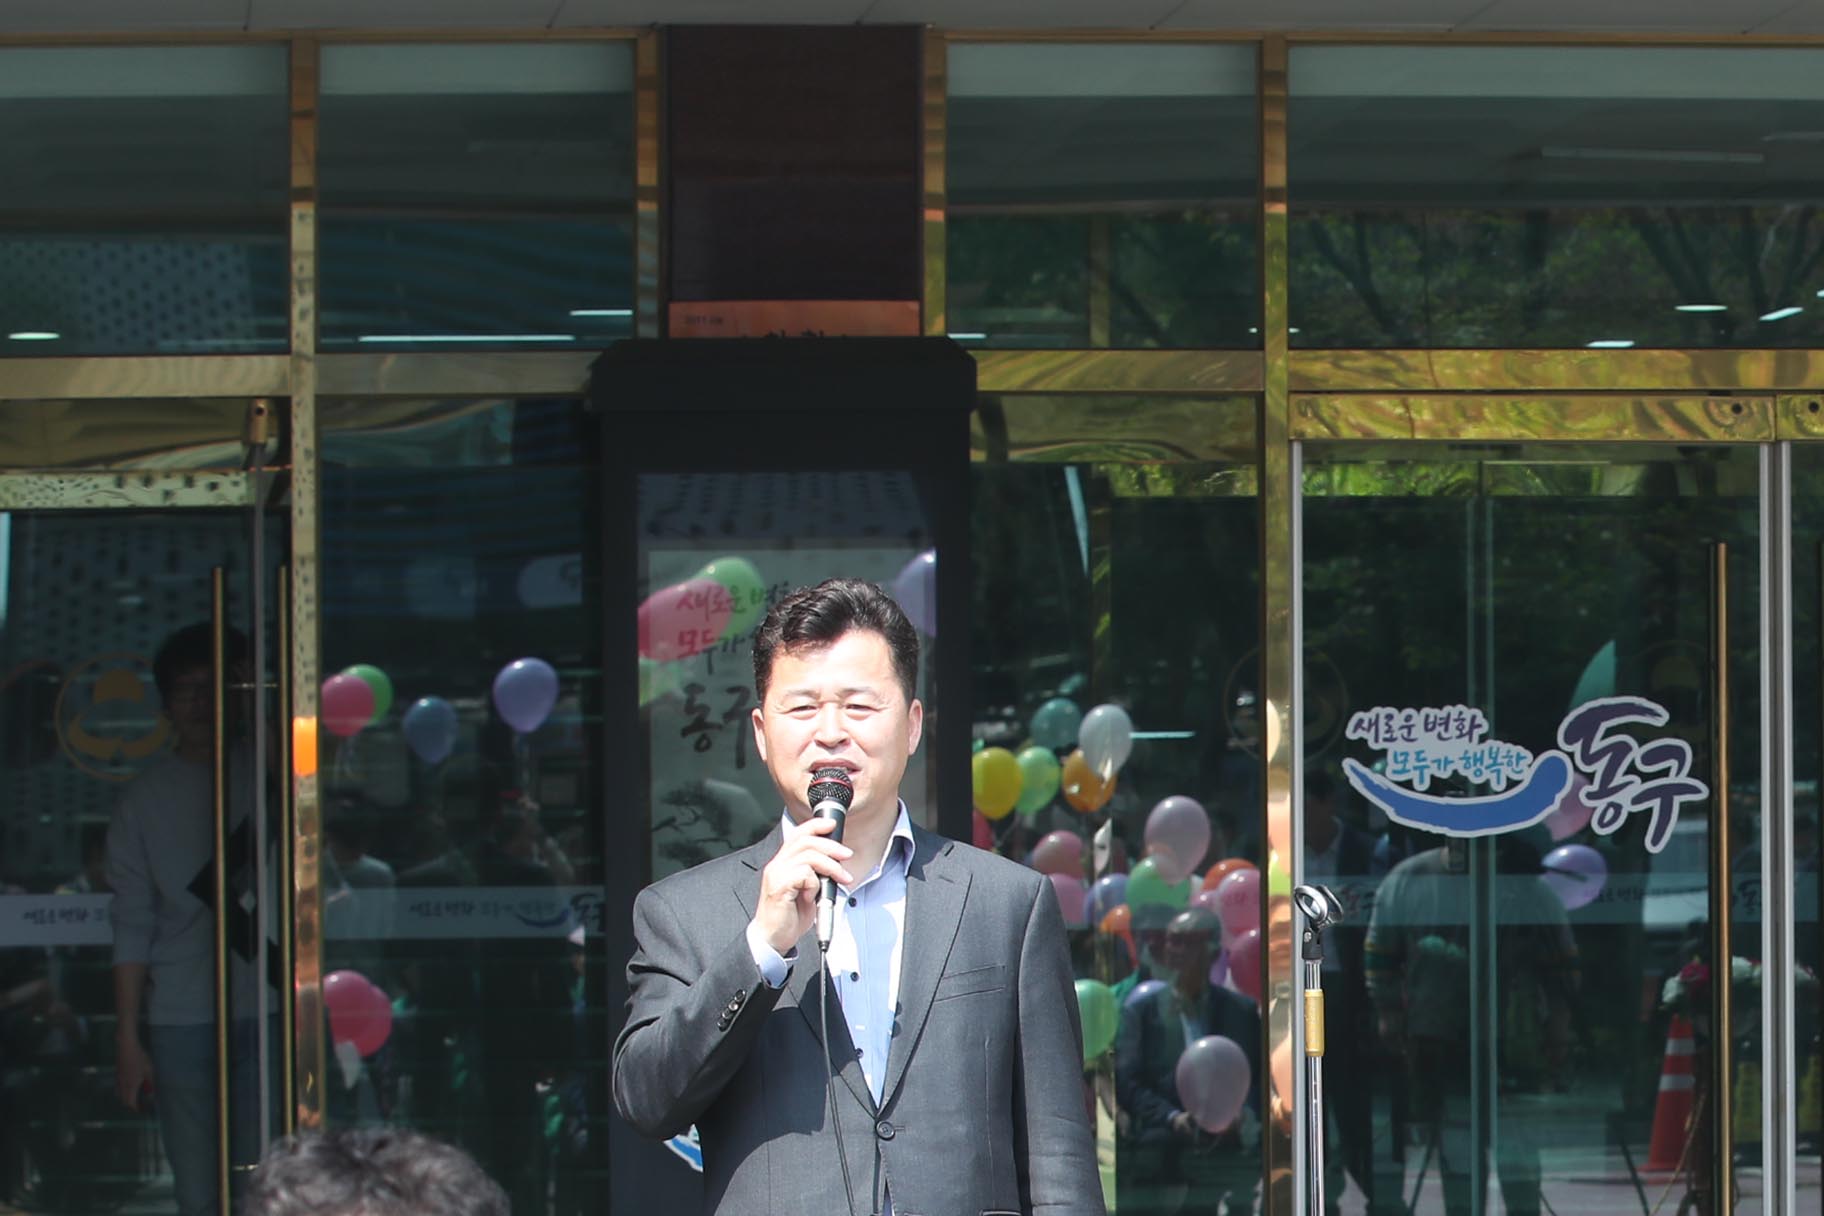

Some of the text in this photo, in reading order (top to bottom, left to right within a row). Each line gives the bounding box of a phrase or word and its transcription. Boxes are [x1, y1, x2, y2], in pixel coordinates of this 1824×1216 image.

[681, 682, 752, 769] 동구
[1352, 709, 1483, 743] 새로운 변화
[1391, 746, 1528, 786] 모두가 행복한
[1561, 700, 1704, 849] 동구
